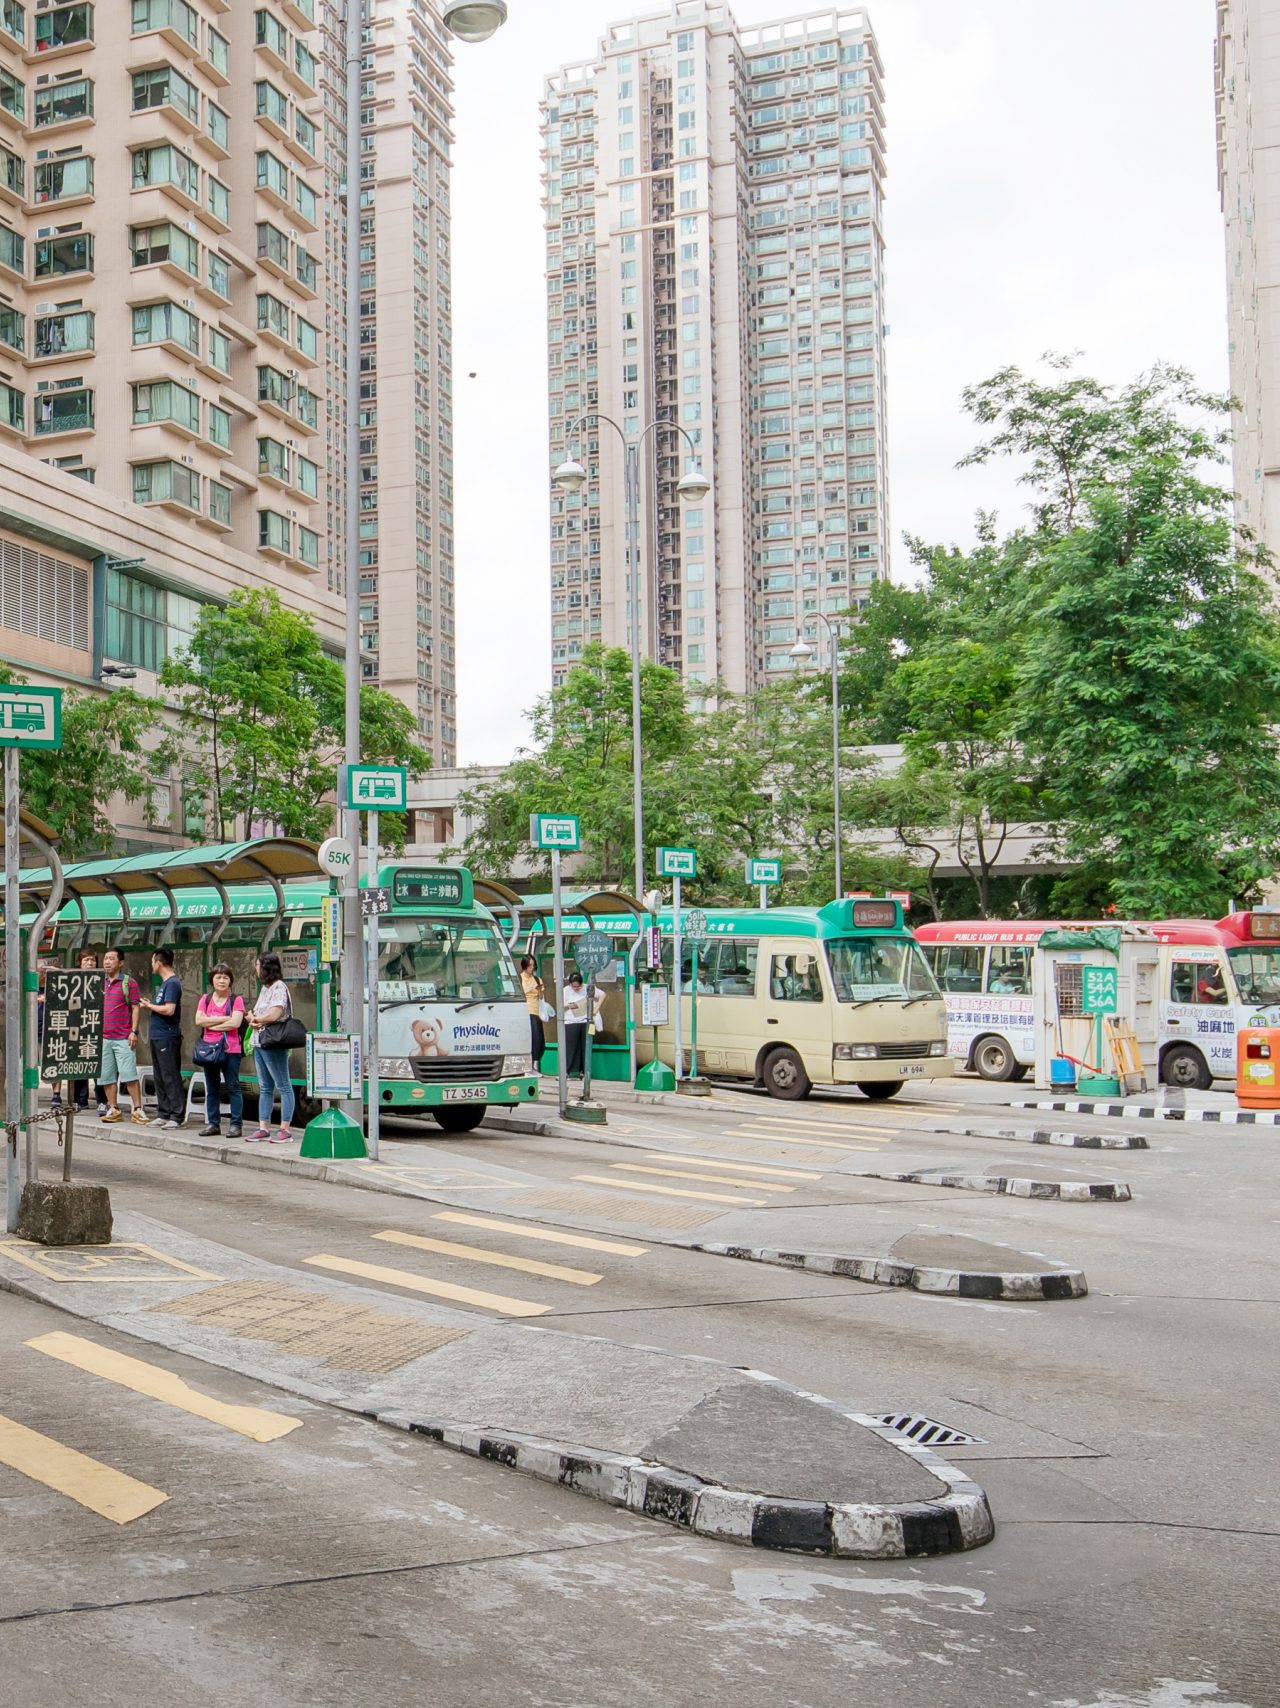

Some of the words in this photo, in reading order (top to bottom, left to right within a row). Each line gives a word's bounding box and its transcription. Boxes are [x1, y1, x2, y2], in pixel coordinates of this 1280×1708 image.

[328, 851, 351, 866] 55K
[186, 904, 208, 915] SEATS
[954, 933, 977, 941] PUBLIC
[978, 933, 998, 941] LIGHT
[1088, 971, 1115, 983] 52A
[57, 975, 95, 1001] 52K
[1087, 982, 1115, 994] 54A
[1088, 995, 1115, 1007] 56A
[1167, 1005, 1203, 1019] Safety
[1206, 1007, 1234, 1019] Card
[453, 1022, 501, 1039] Physiolac
[1210, 1047, 1233, 1059] 火炭
[58, 1061, 98, 1075] 26690737
[444, 1089, 458, 1099] TZ
[460, 1087, 486, 1099] 3545
